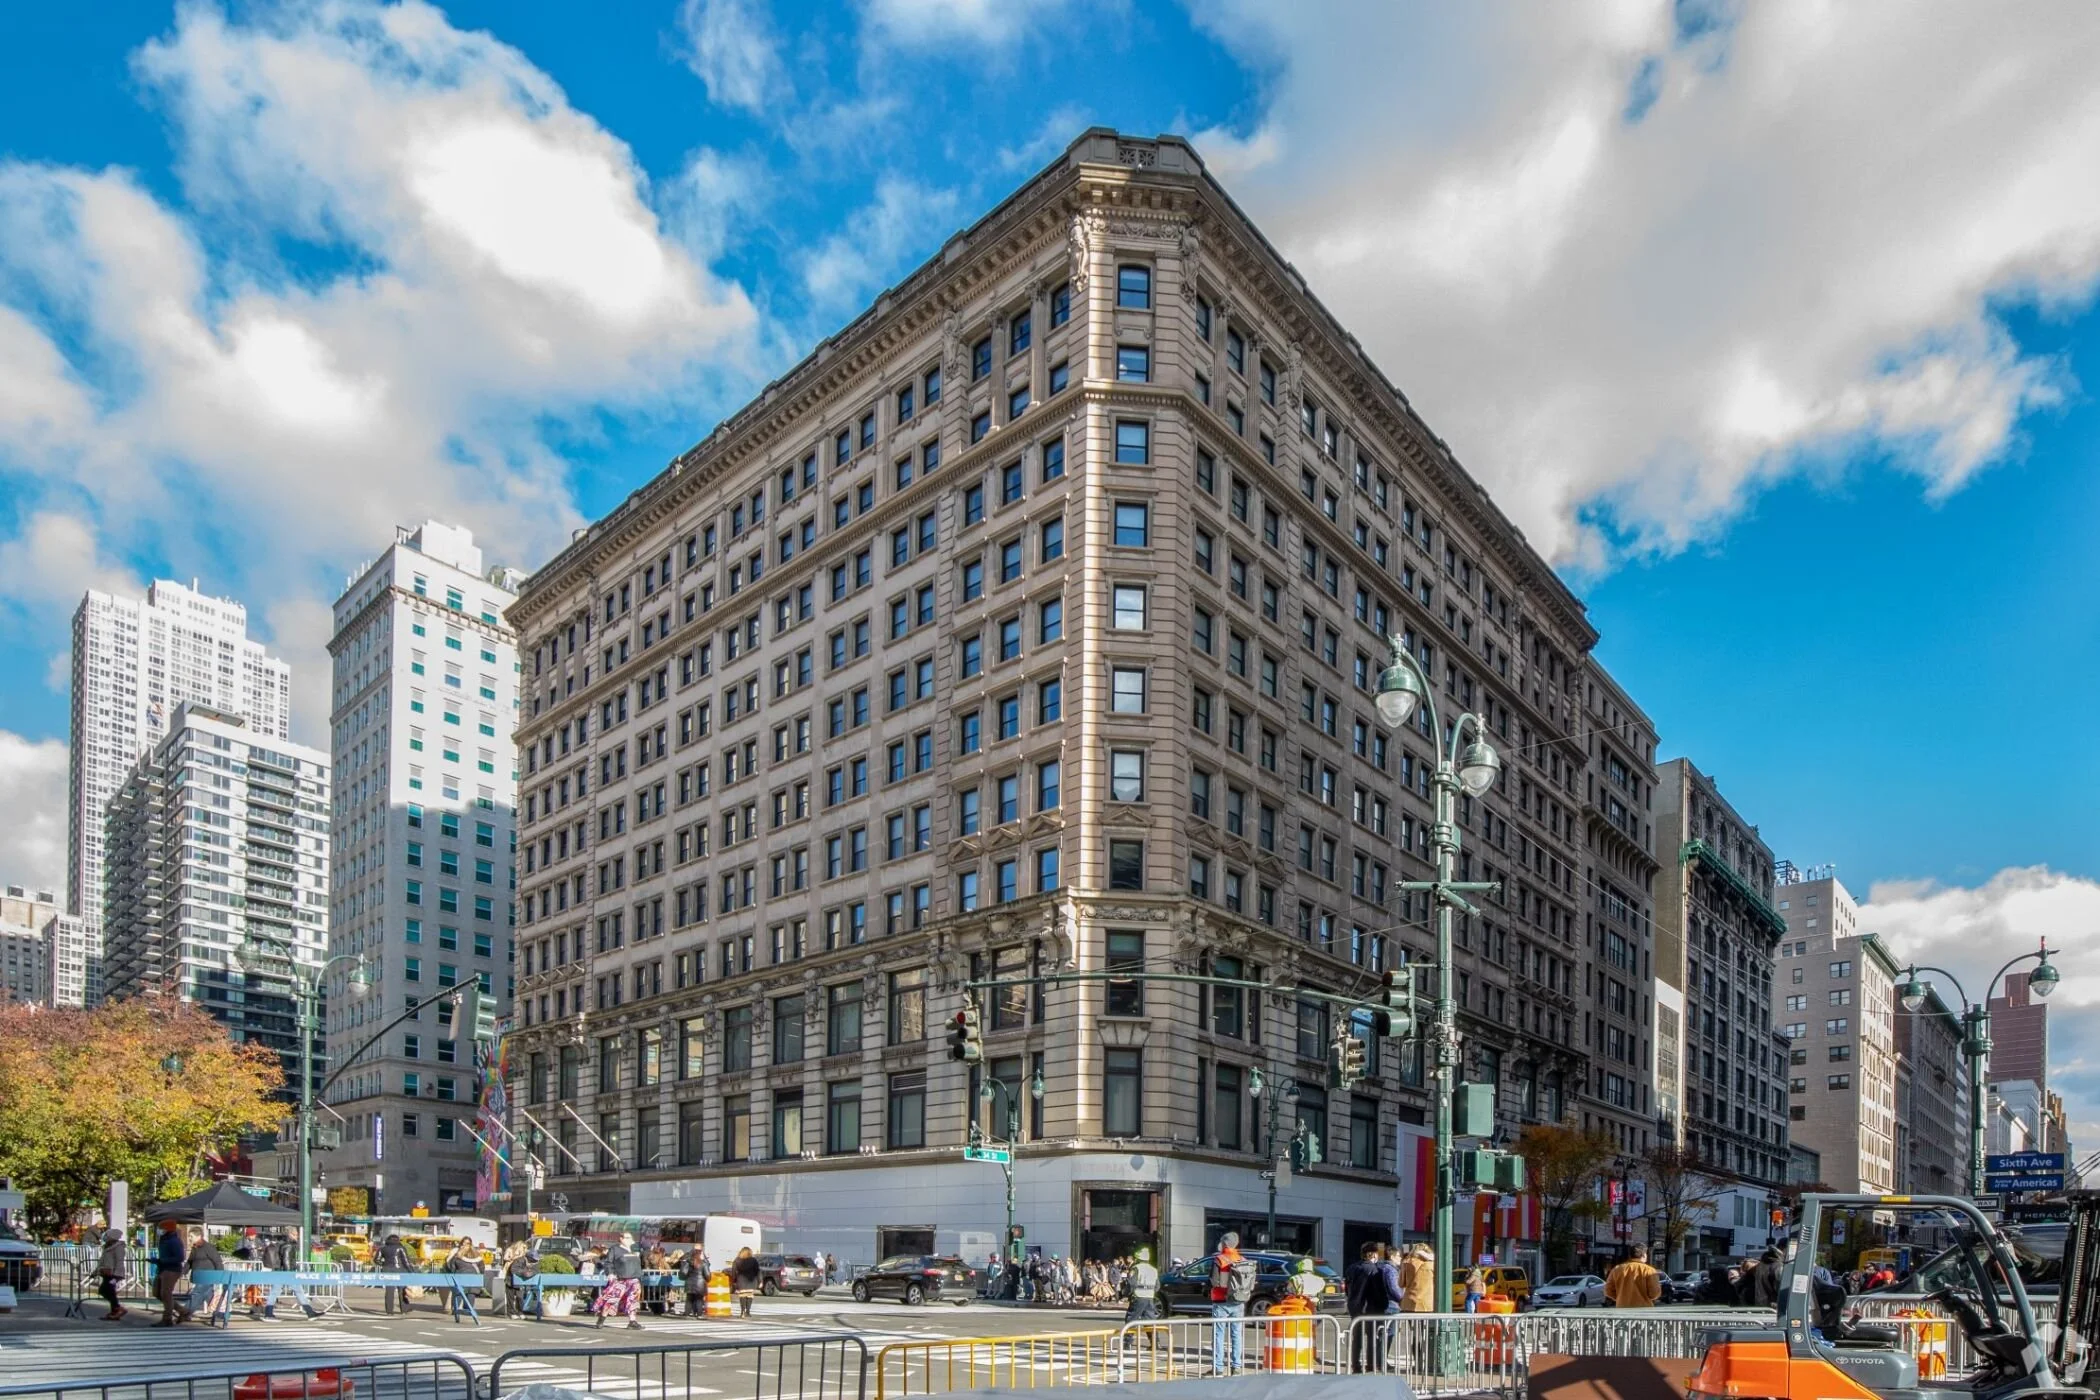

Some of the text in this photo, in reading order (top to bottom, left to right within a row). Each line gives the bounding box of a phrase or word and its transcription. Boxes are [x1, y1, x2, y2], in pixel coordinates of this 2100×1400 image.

[1999, 1158, 2053, 1168] Sixth Ave
[2012, 1178, 2057, 1188] Americas
[1850, 1357, 1885, 1365] TOYOTA
